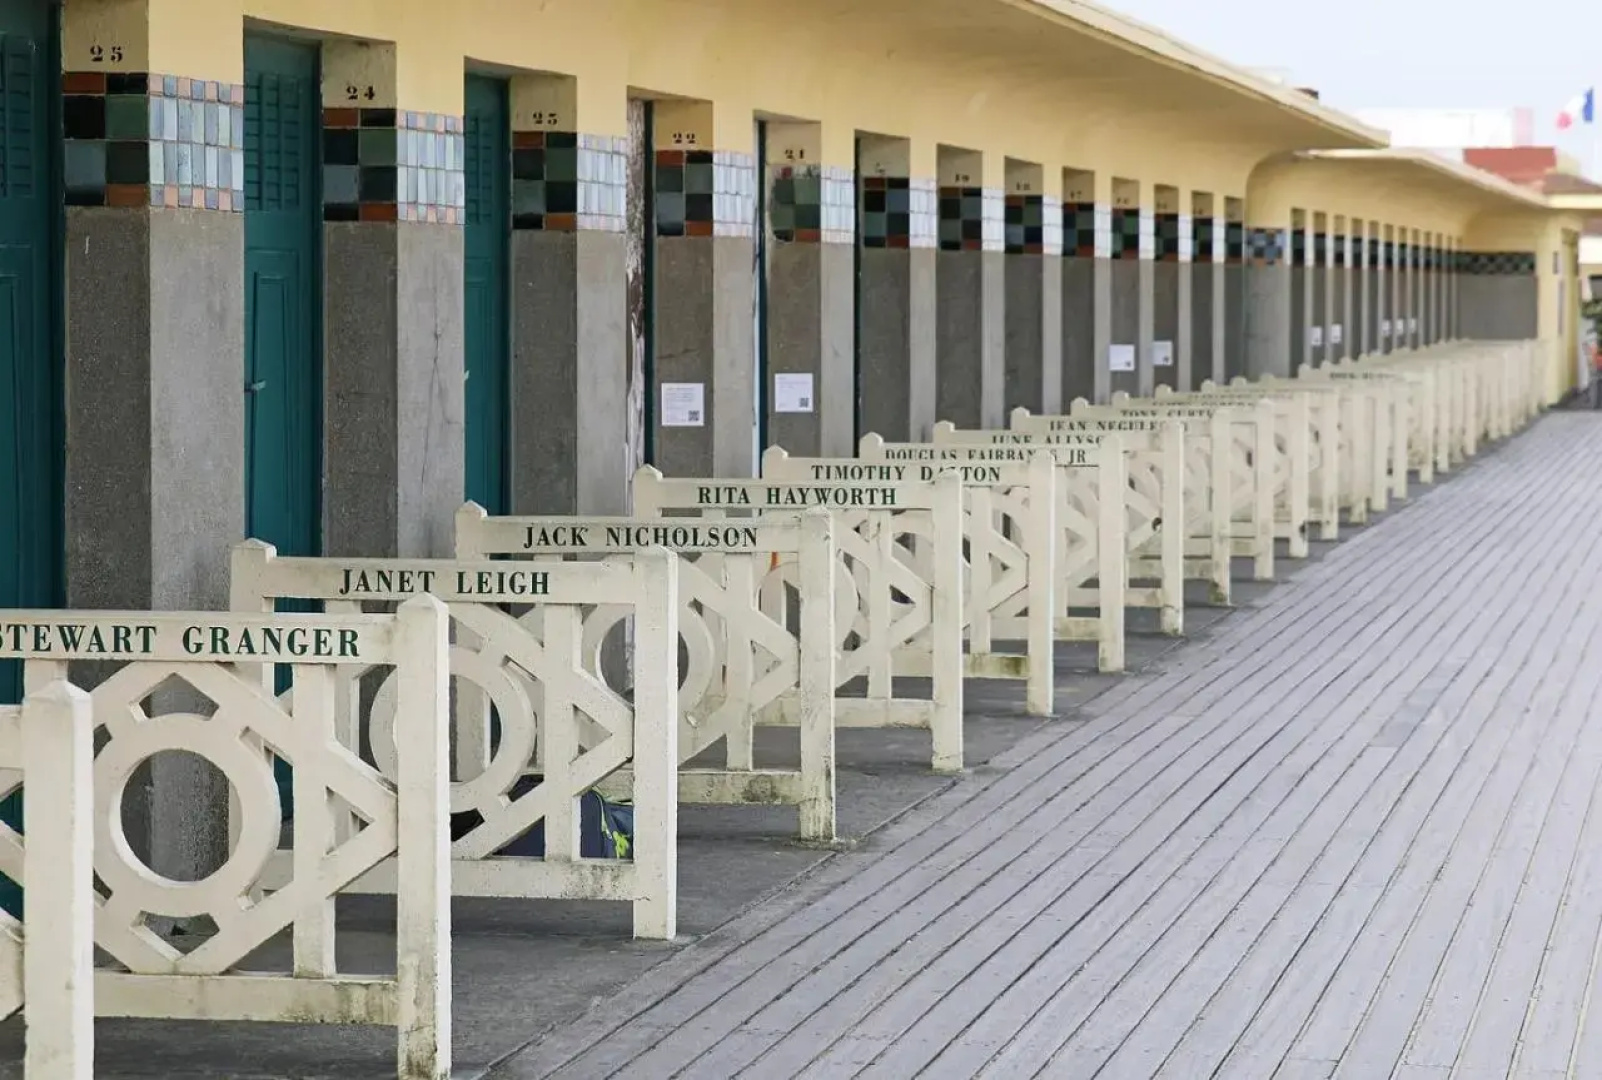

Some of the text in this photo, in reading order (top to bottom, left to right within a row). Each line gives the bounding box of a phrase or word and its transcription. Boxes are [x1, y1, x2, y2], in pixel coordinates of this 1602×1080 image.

[89, 45, 123, 63] 25
[345, 85, 376, 101] 24
[672, 133, 696, 144] 22
[785, 148, 804, 160] 21
[812, 465, 1001, 482] TIMOTHY DTON
[698, 487, 897, 506] RITA HAYWORTH
[523, 525, 758, 548] JACK NICHOLSON
[339, 569, 550, 595] JANET LEIGH
[0, 623, 361, 658] TEWART GRANGER
